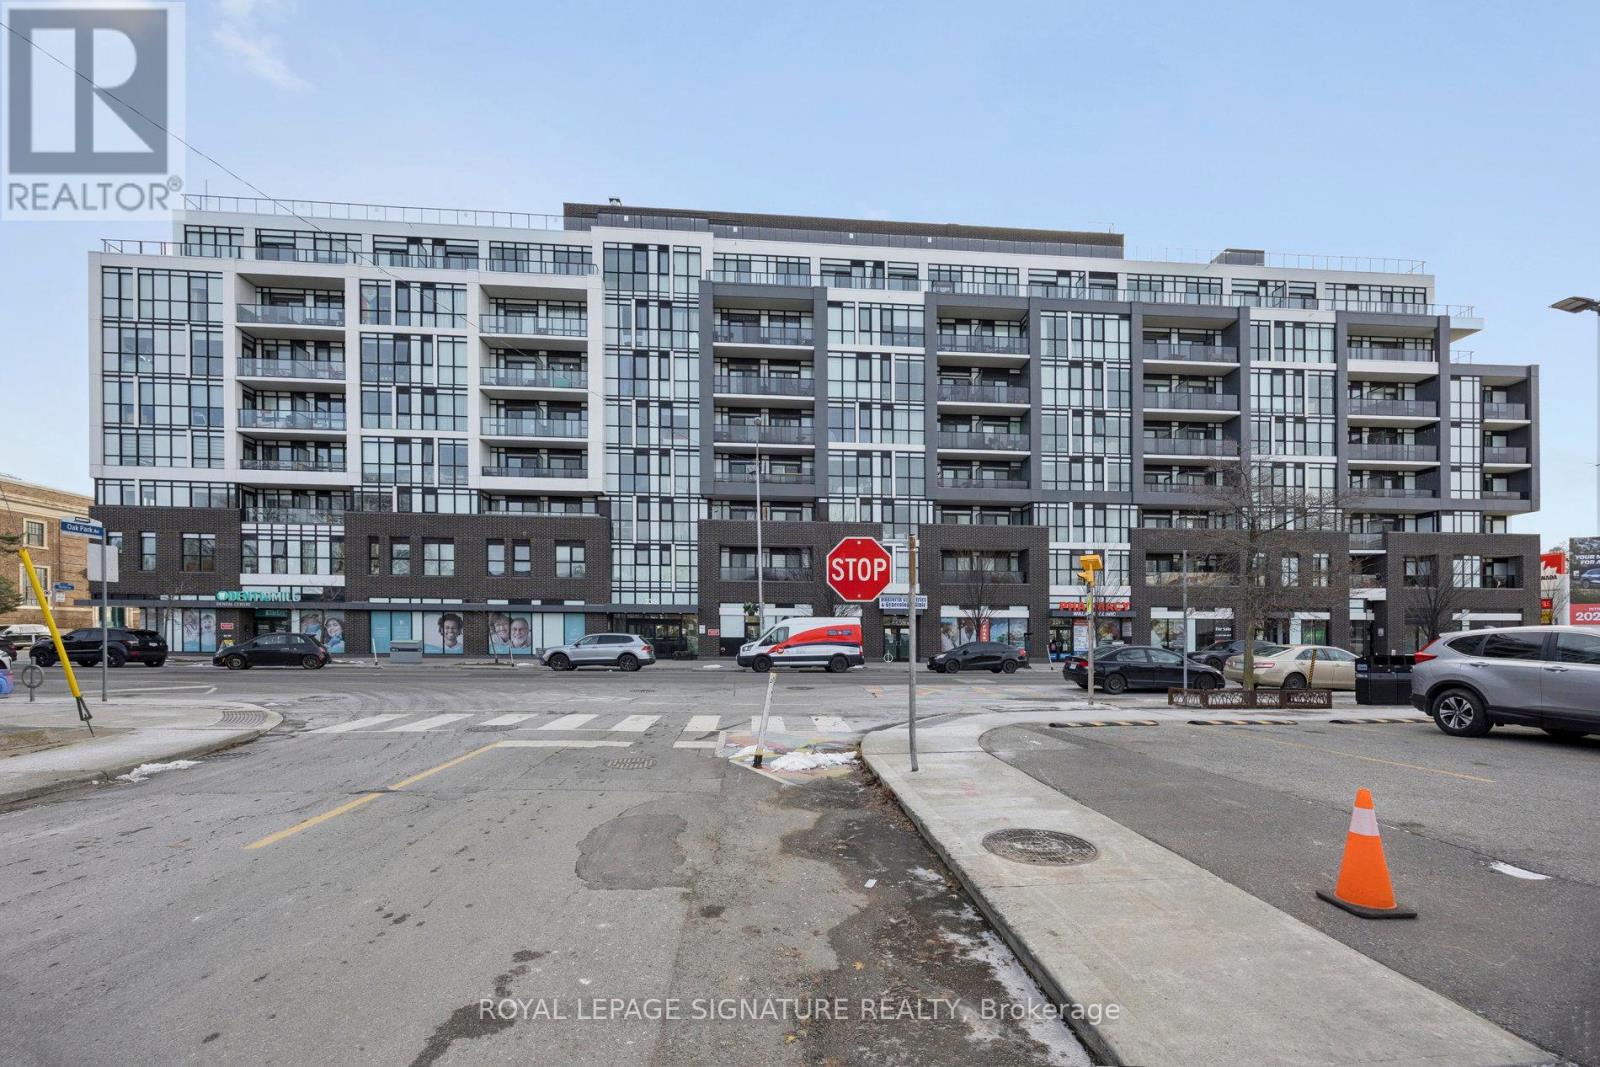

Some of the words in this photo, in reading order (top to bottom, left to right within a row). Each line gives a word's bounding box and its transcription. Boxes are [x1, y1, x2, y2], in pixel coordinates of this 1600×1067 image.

[67, 523, 79, 531] Oak
[80, 525, 93, 533] Park
[831, 557, 887, 582] STOP
[1059, 602, 1130, 611] PHAMACY
